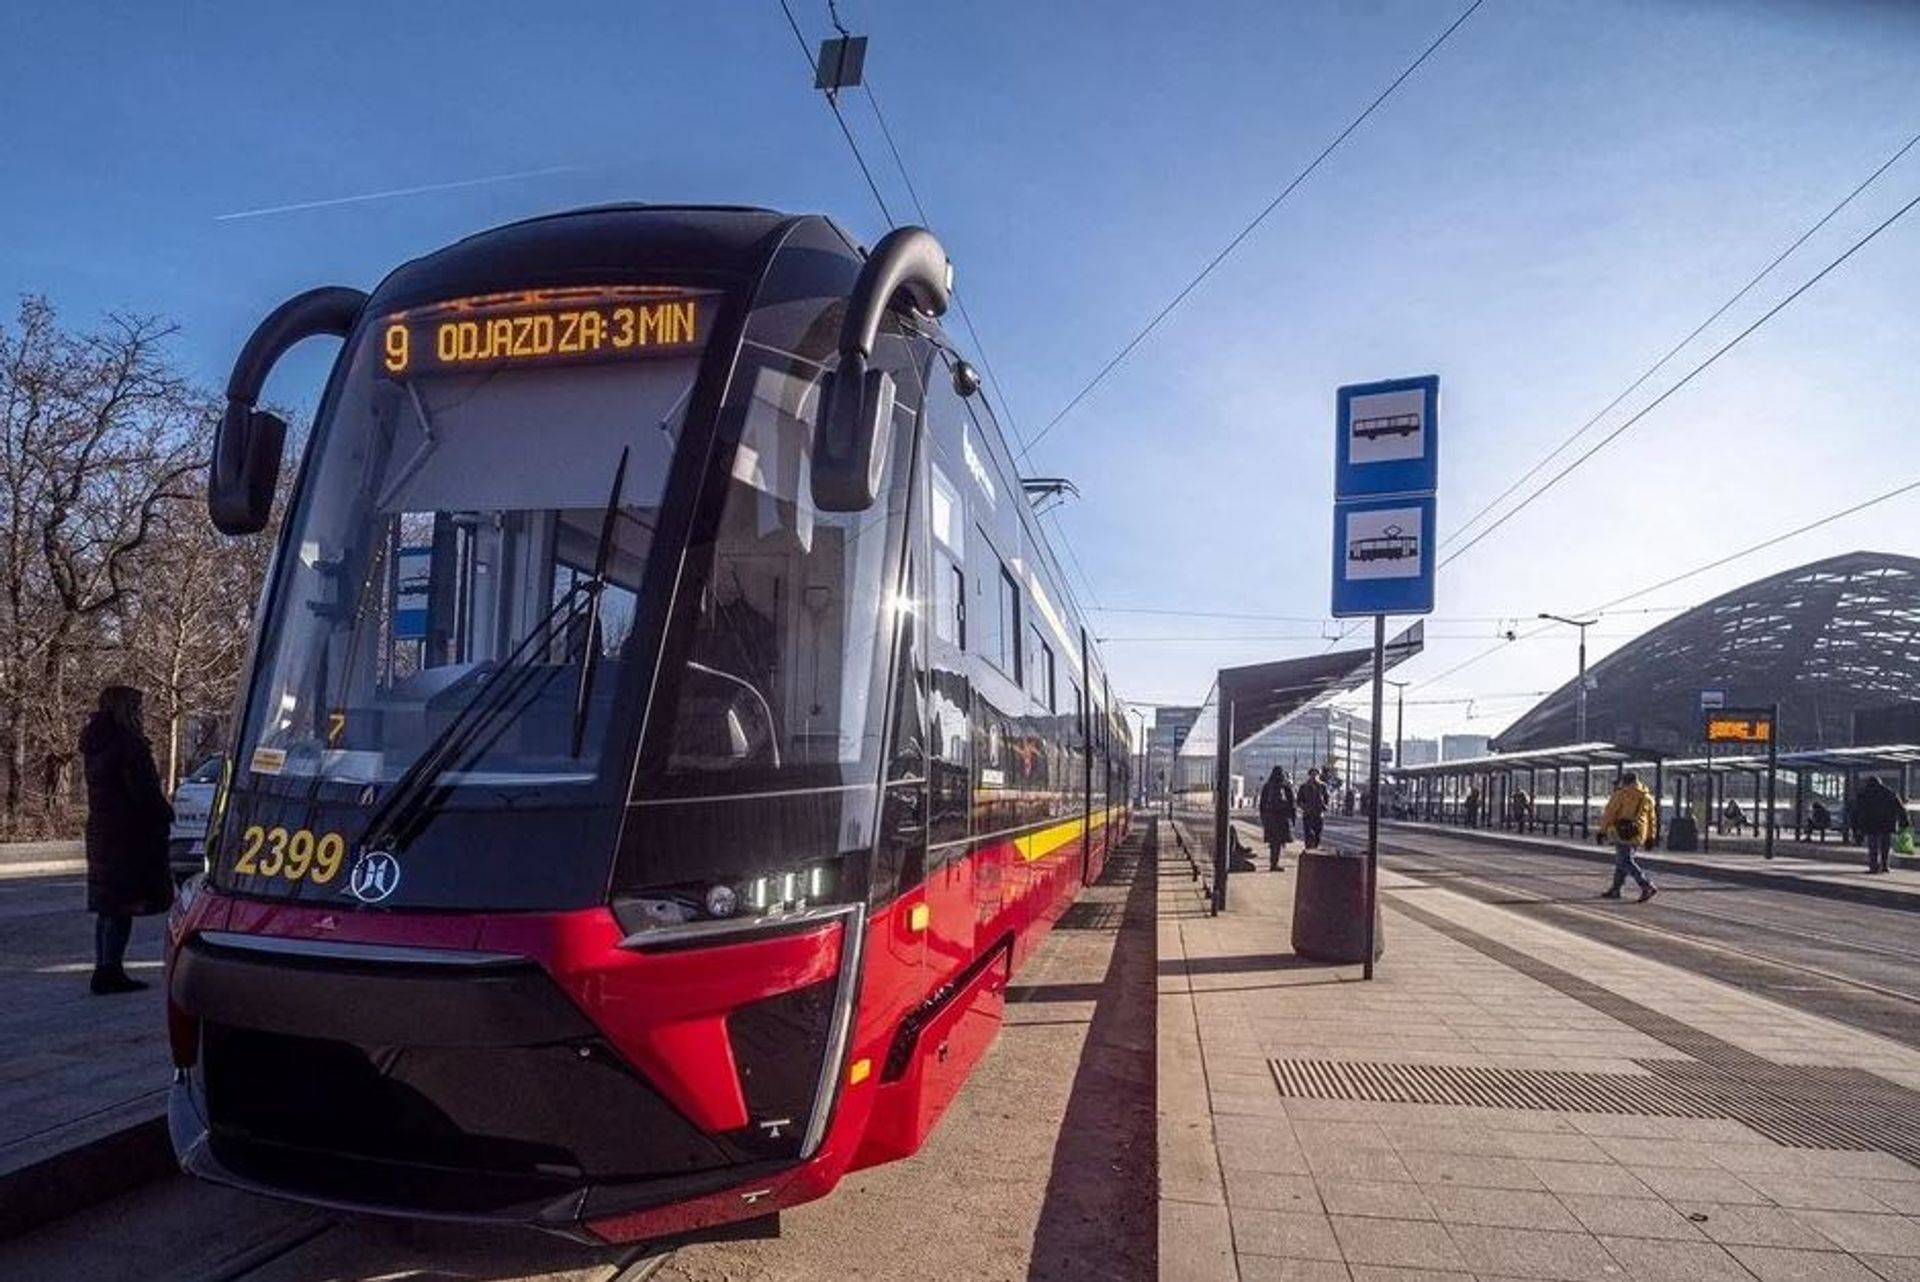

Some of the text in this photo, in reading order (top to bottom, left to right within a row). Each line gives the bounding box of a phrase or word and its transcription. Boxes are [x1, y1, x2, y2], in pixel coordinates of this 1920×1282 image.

[385, 302, 696, 372] 9 ODJAZD ZA: 3 MIN
[328, 713, 345, 741] 7
[233, 825, 345, 884] 2399
